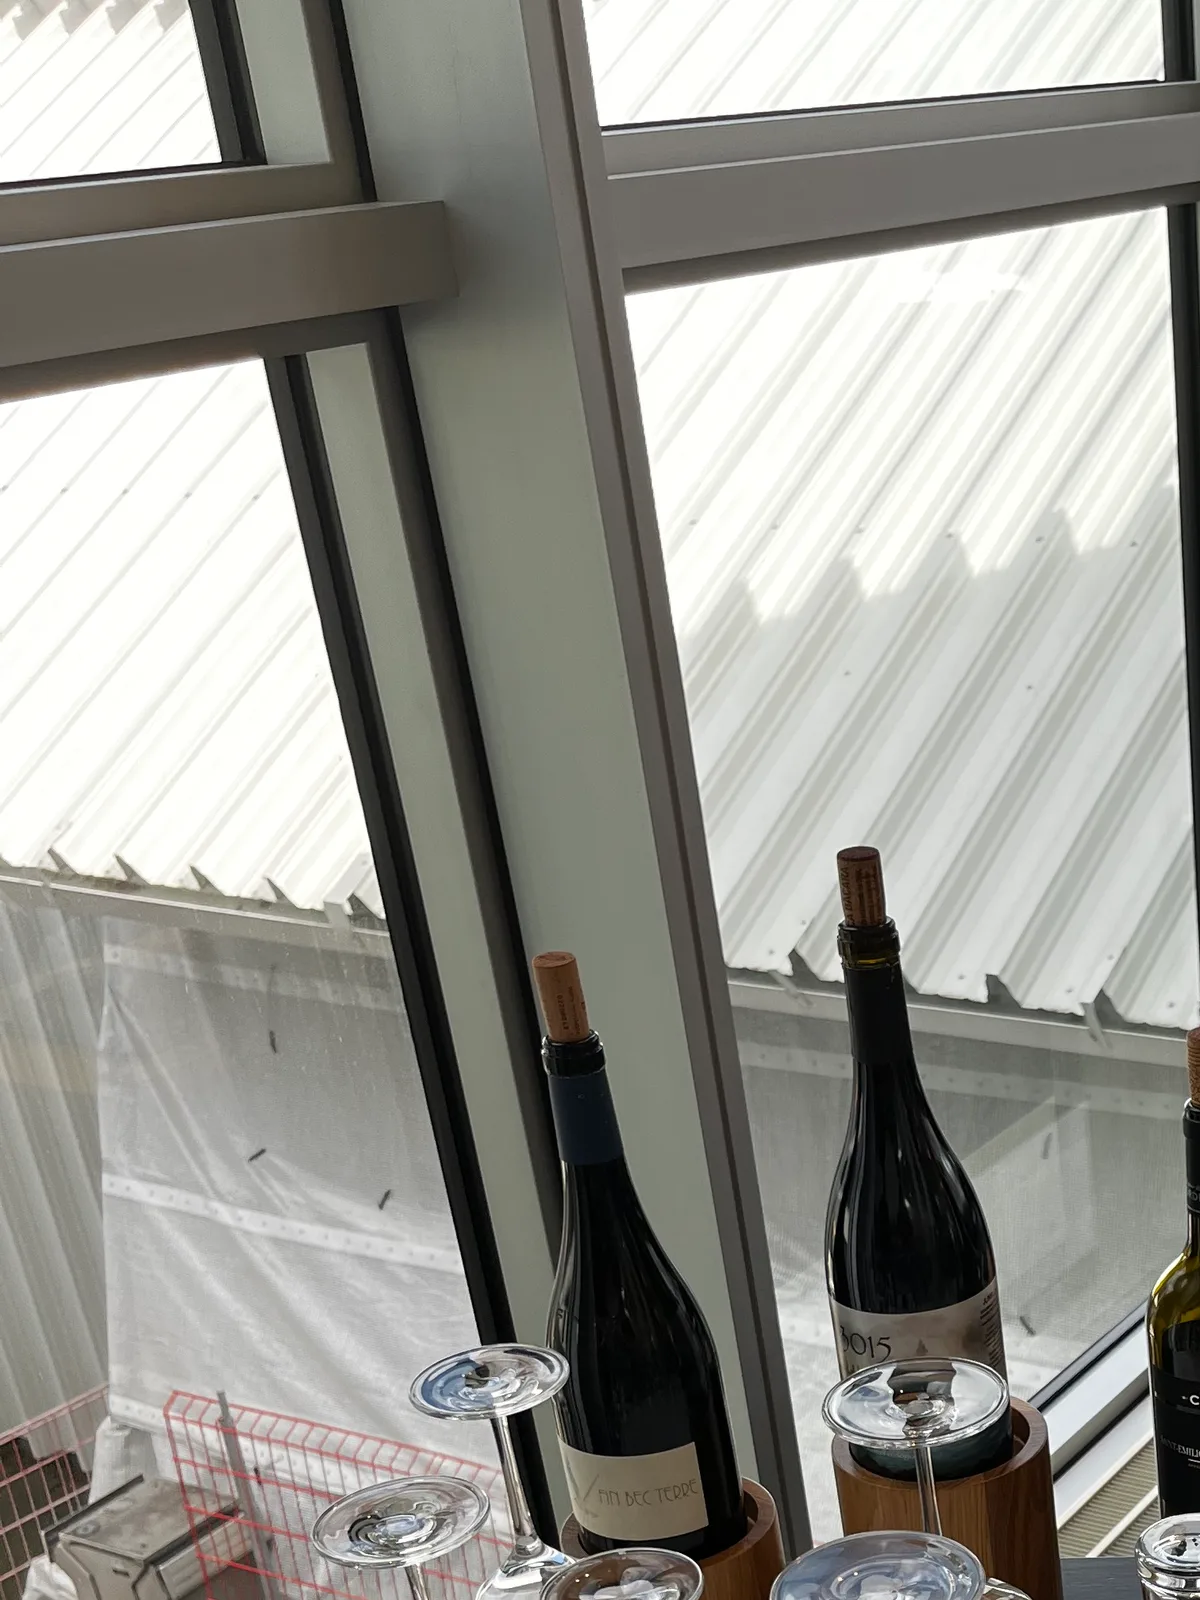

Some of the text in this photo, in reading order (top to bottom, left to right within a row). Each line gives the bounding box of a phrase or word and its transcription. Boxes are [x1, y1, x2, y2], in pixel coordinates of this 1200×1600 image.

[840, 1325, 892, 1363] 3015
[625, 1489, 651, 1507] BEC
[655, 1478, 699, 1503] TERRE
